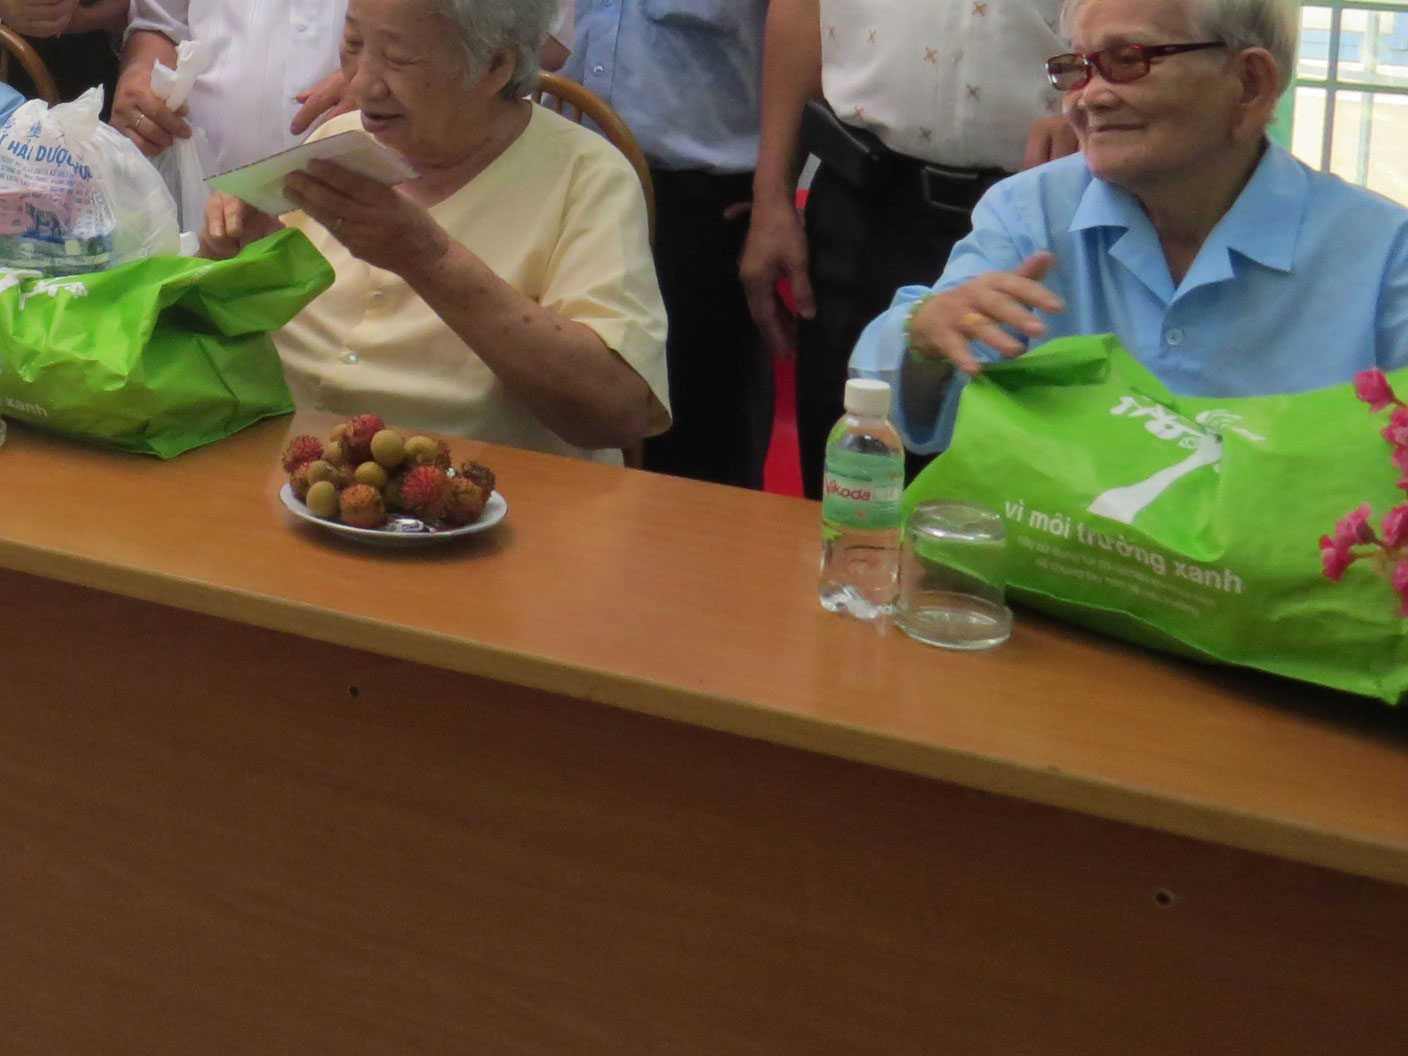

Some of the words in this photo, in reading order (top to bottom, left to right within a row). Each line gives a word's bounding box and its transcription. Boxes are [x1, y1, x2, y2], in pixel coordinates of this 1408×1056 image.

[1005, 498, 1025, 523] vì
[1029, 509, 1072, 540] môi
[1077, 521, 1169, 577] trường
[1175, 559, 1242, 595] xanh
